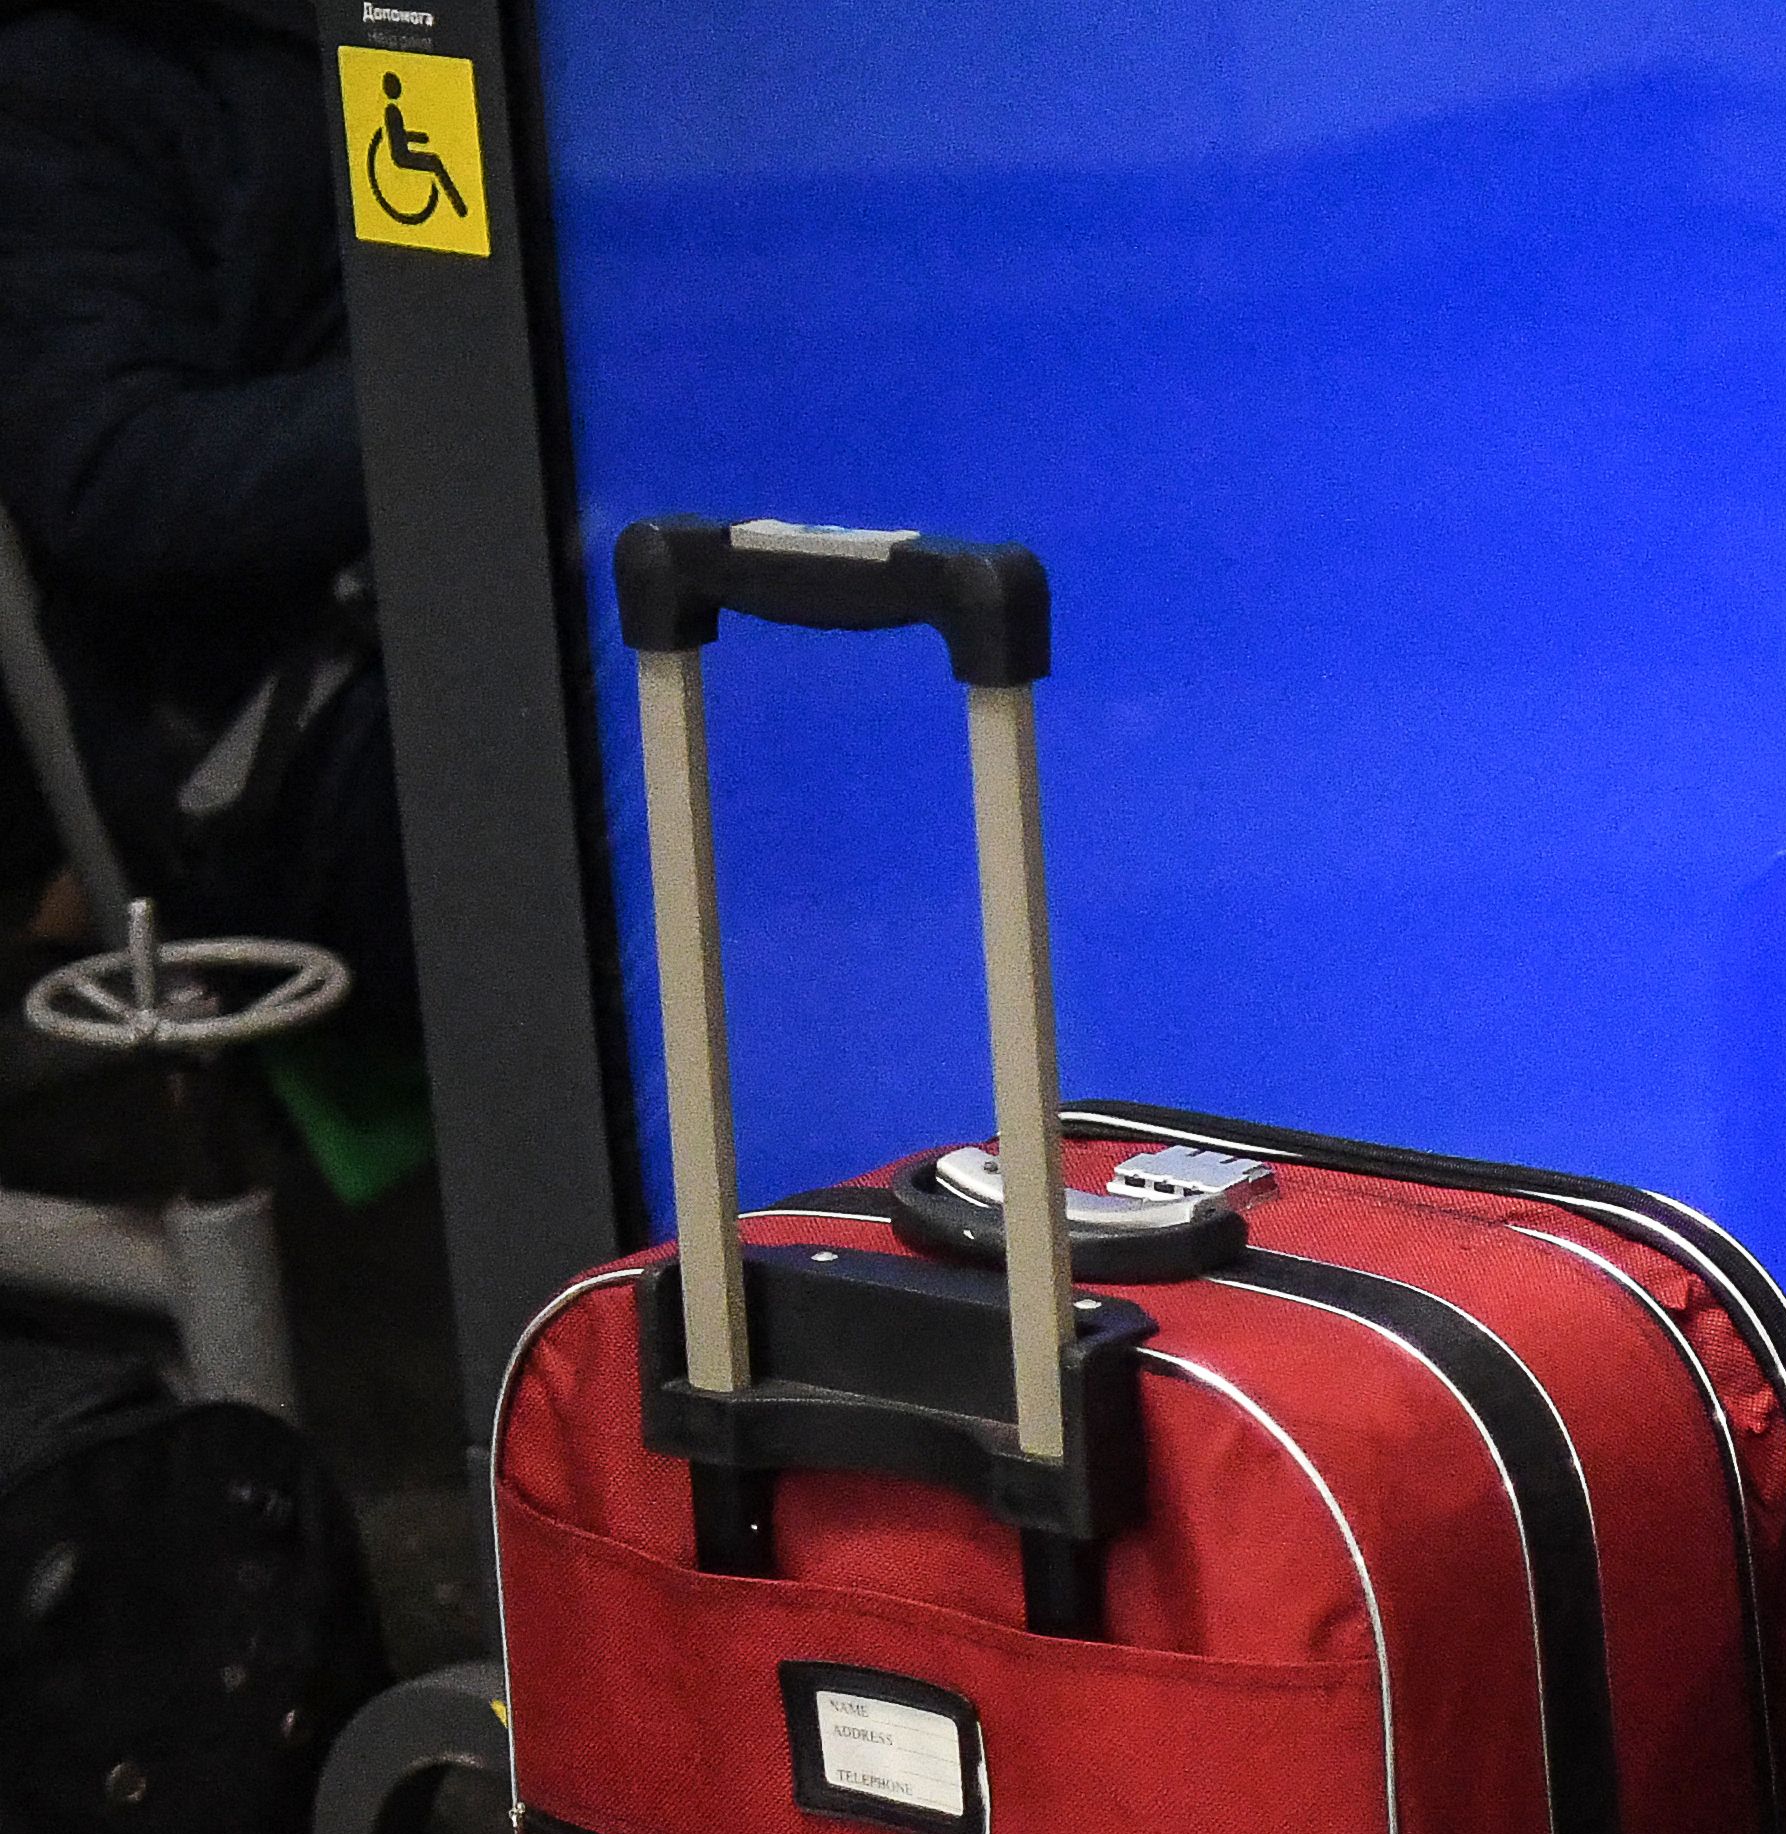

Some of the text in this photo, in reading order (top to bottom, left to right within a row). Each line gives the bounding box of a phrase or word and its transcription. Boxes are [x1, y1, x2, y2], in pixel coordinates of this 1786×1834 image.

[362, 2, 433, 26] Допомога
[829, 1699, 869, 1718] NAME
[833, 1725, 894, 1747] ADDRESS
[837, 1769, 913, 1796] TELEPHONE
